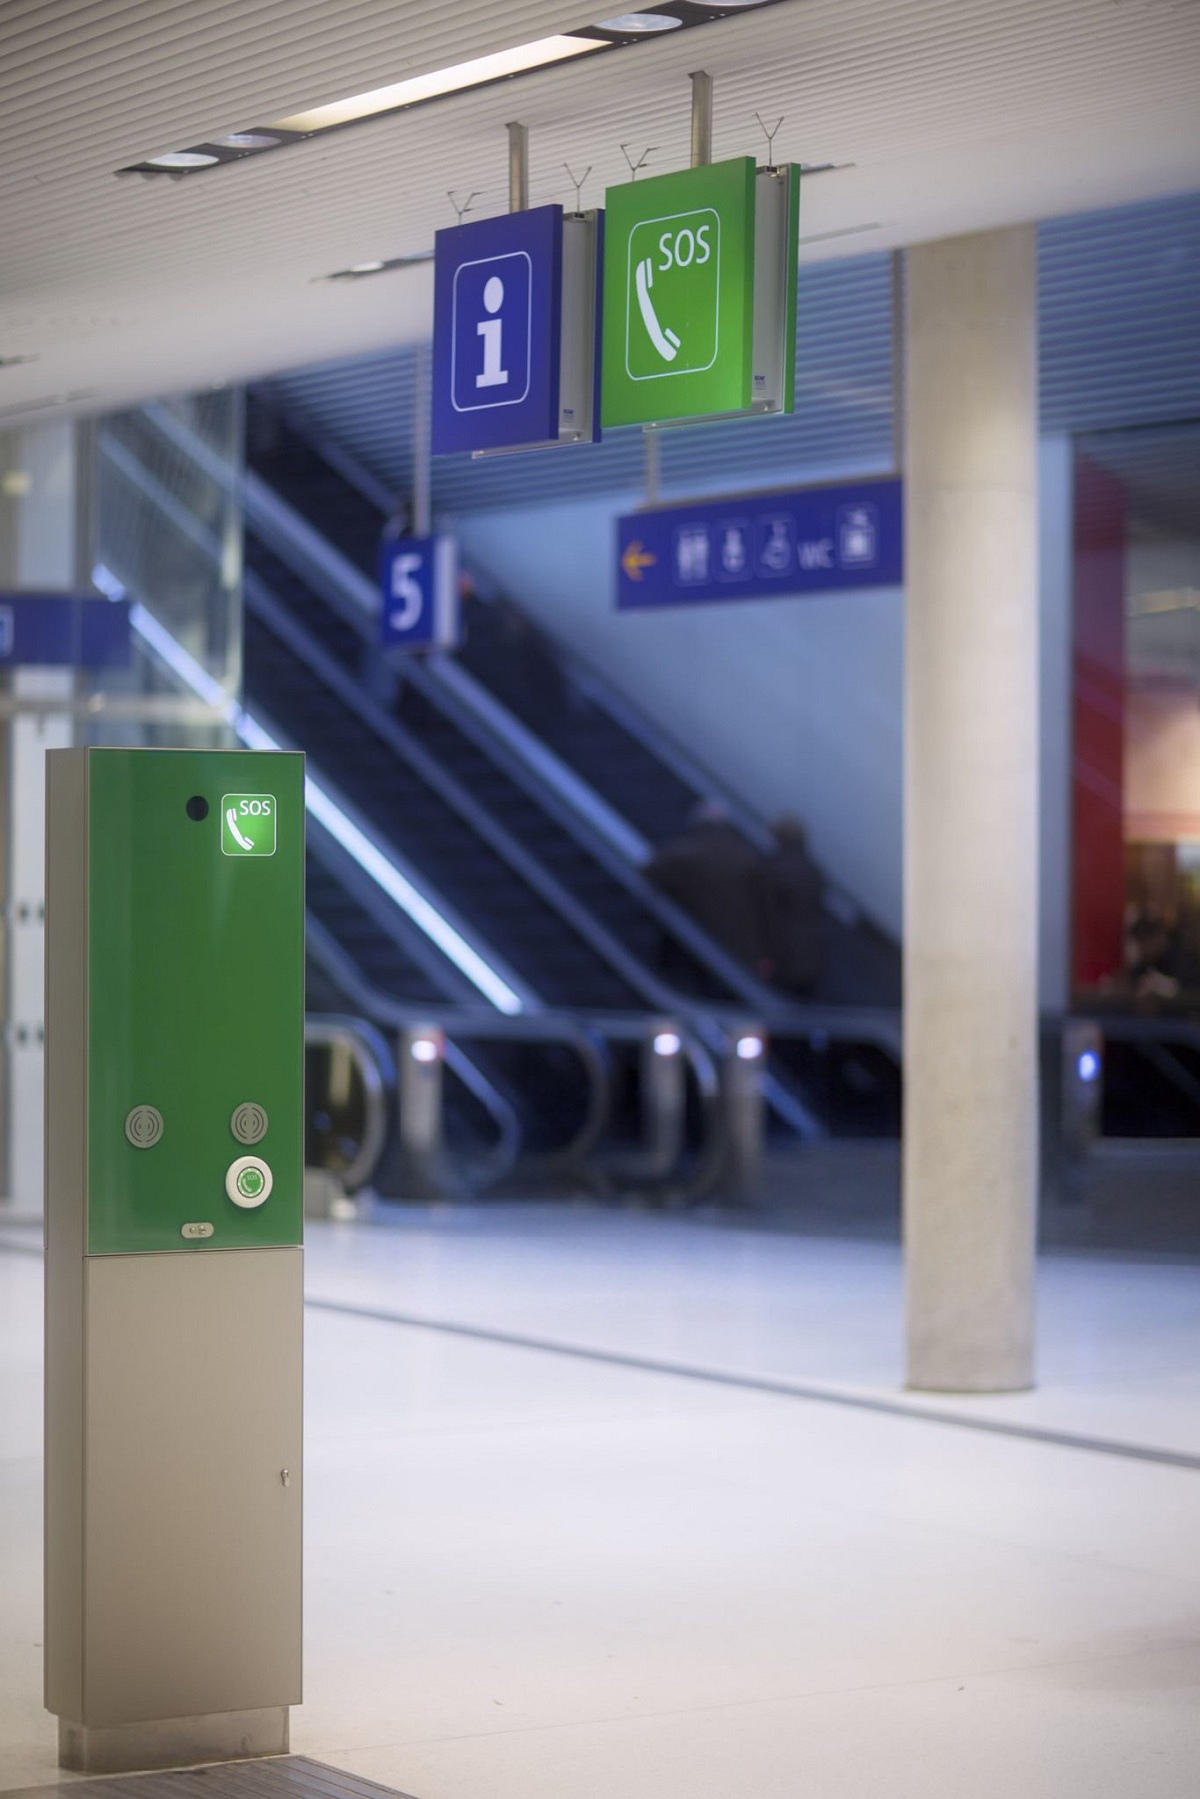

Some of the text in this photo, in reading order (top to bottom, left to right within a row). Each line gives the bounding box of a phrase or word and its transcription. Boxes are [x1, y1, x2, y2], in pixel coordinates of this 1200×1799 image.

[658, 225, 710, 271] SOS
[389, 553, 423, 632] 5
[239, 800, 271, 816] SOS
